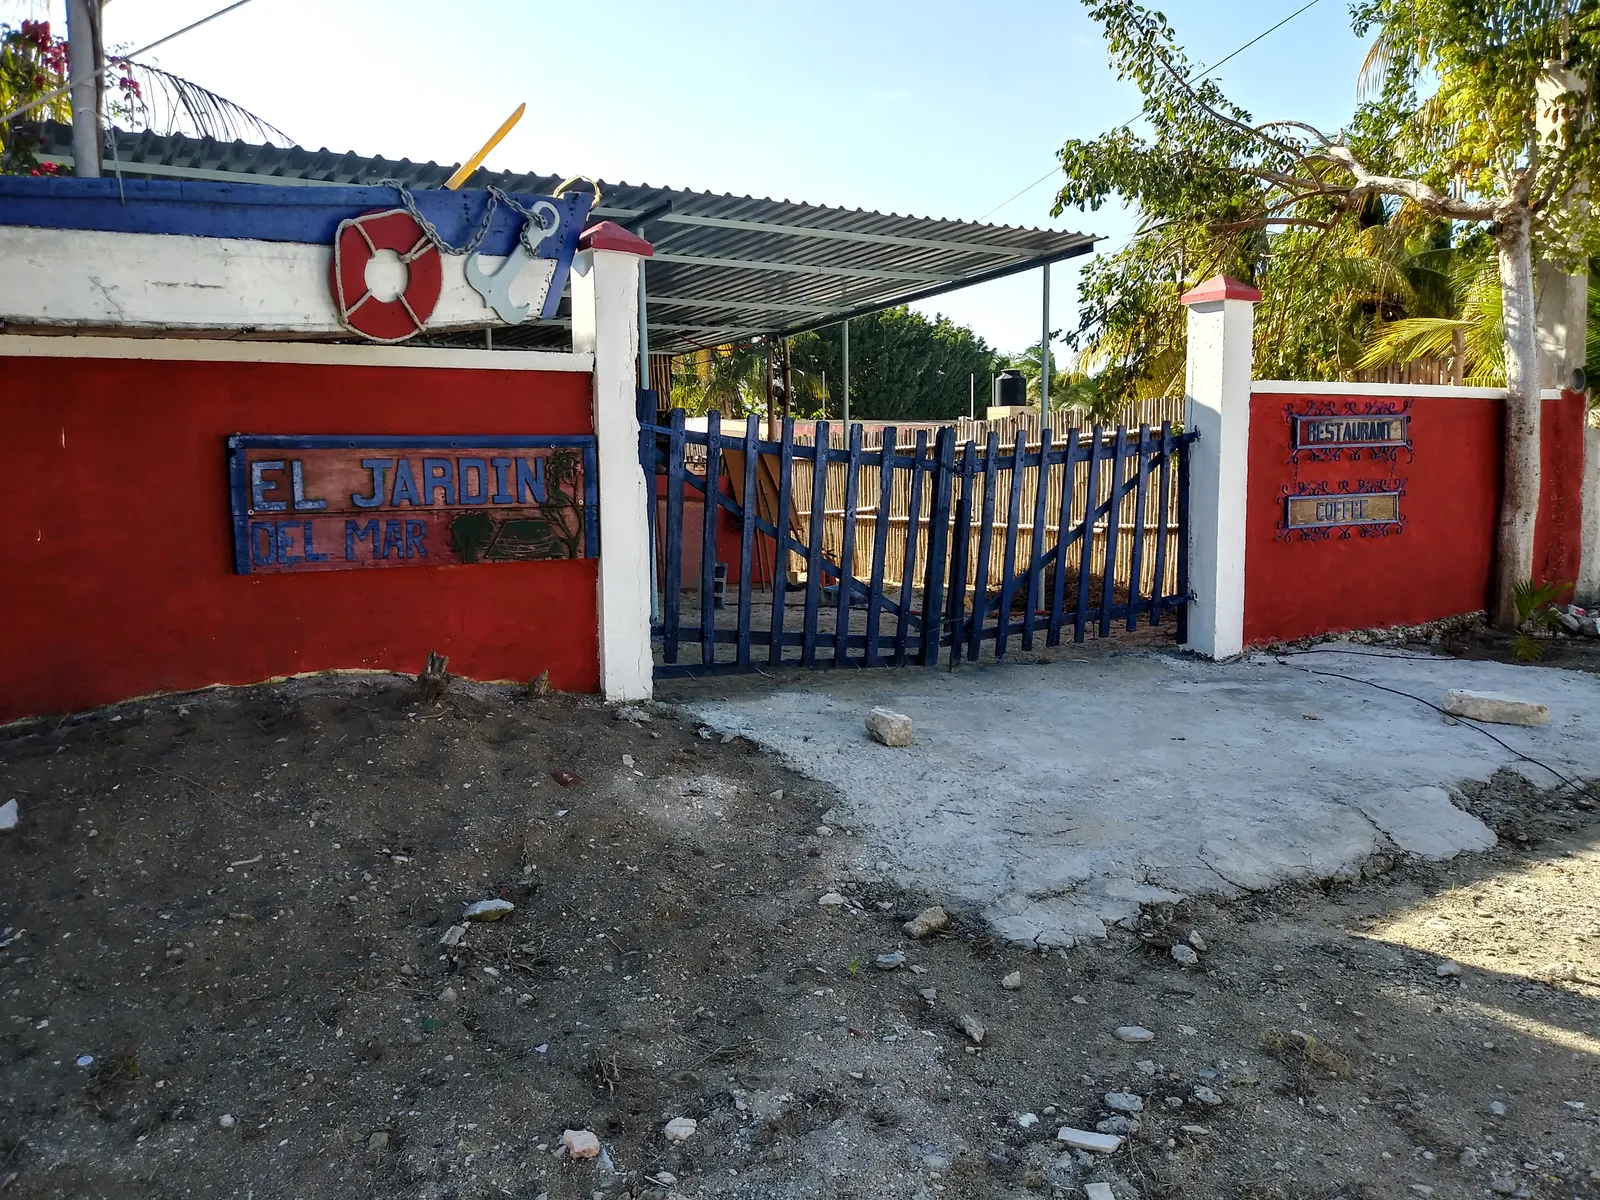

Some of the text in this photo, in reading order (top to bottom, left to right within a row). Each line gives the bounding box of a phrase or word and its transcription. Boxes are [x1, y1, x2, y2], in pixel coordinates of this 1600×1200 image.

[1308, 421, 1394, 442] RESTAURANT
[251, 457, 546, 512] EL JARDIN
[1316, 499, 1369, 522] COFFEE
[251, 518, 428, 566] DEL MAR
